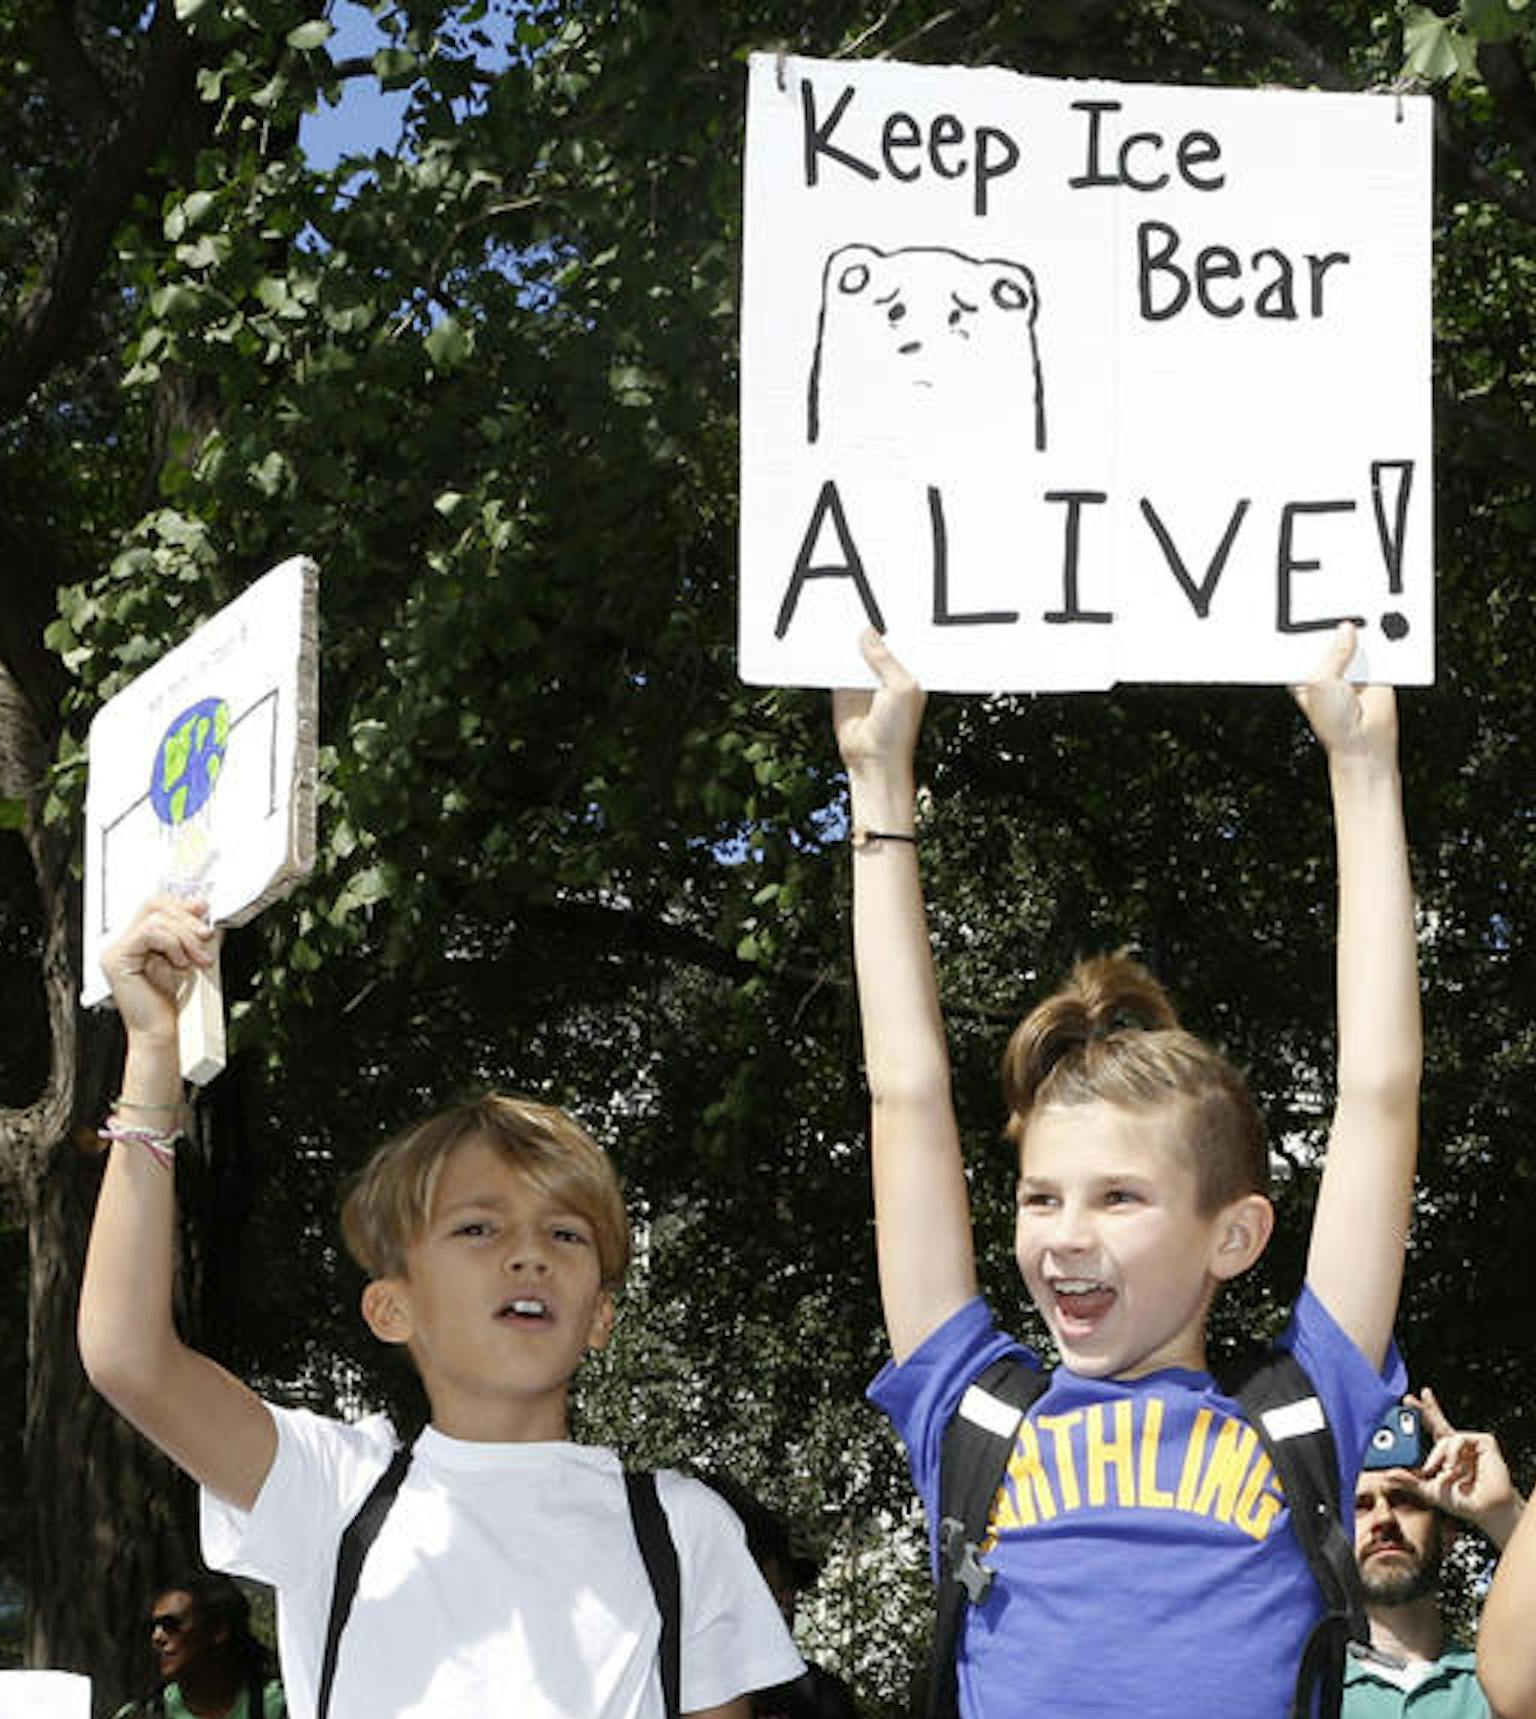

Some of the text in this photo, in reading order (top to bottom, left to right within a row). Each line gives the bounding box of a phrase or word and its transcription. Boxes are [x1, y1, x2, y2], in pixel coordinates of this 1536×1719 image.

[801, 79, 1226, 216] Keep Ice
[1137, 221, 1350, 321] Bear
[774, 460, 1415, 641] ALIVE!
